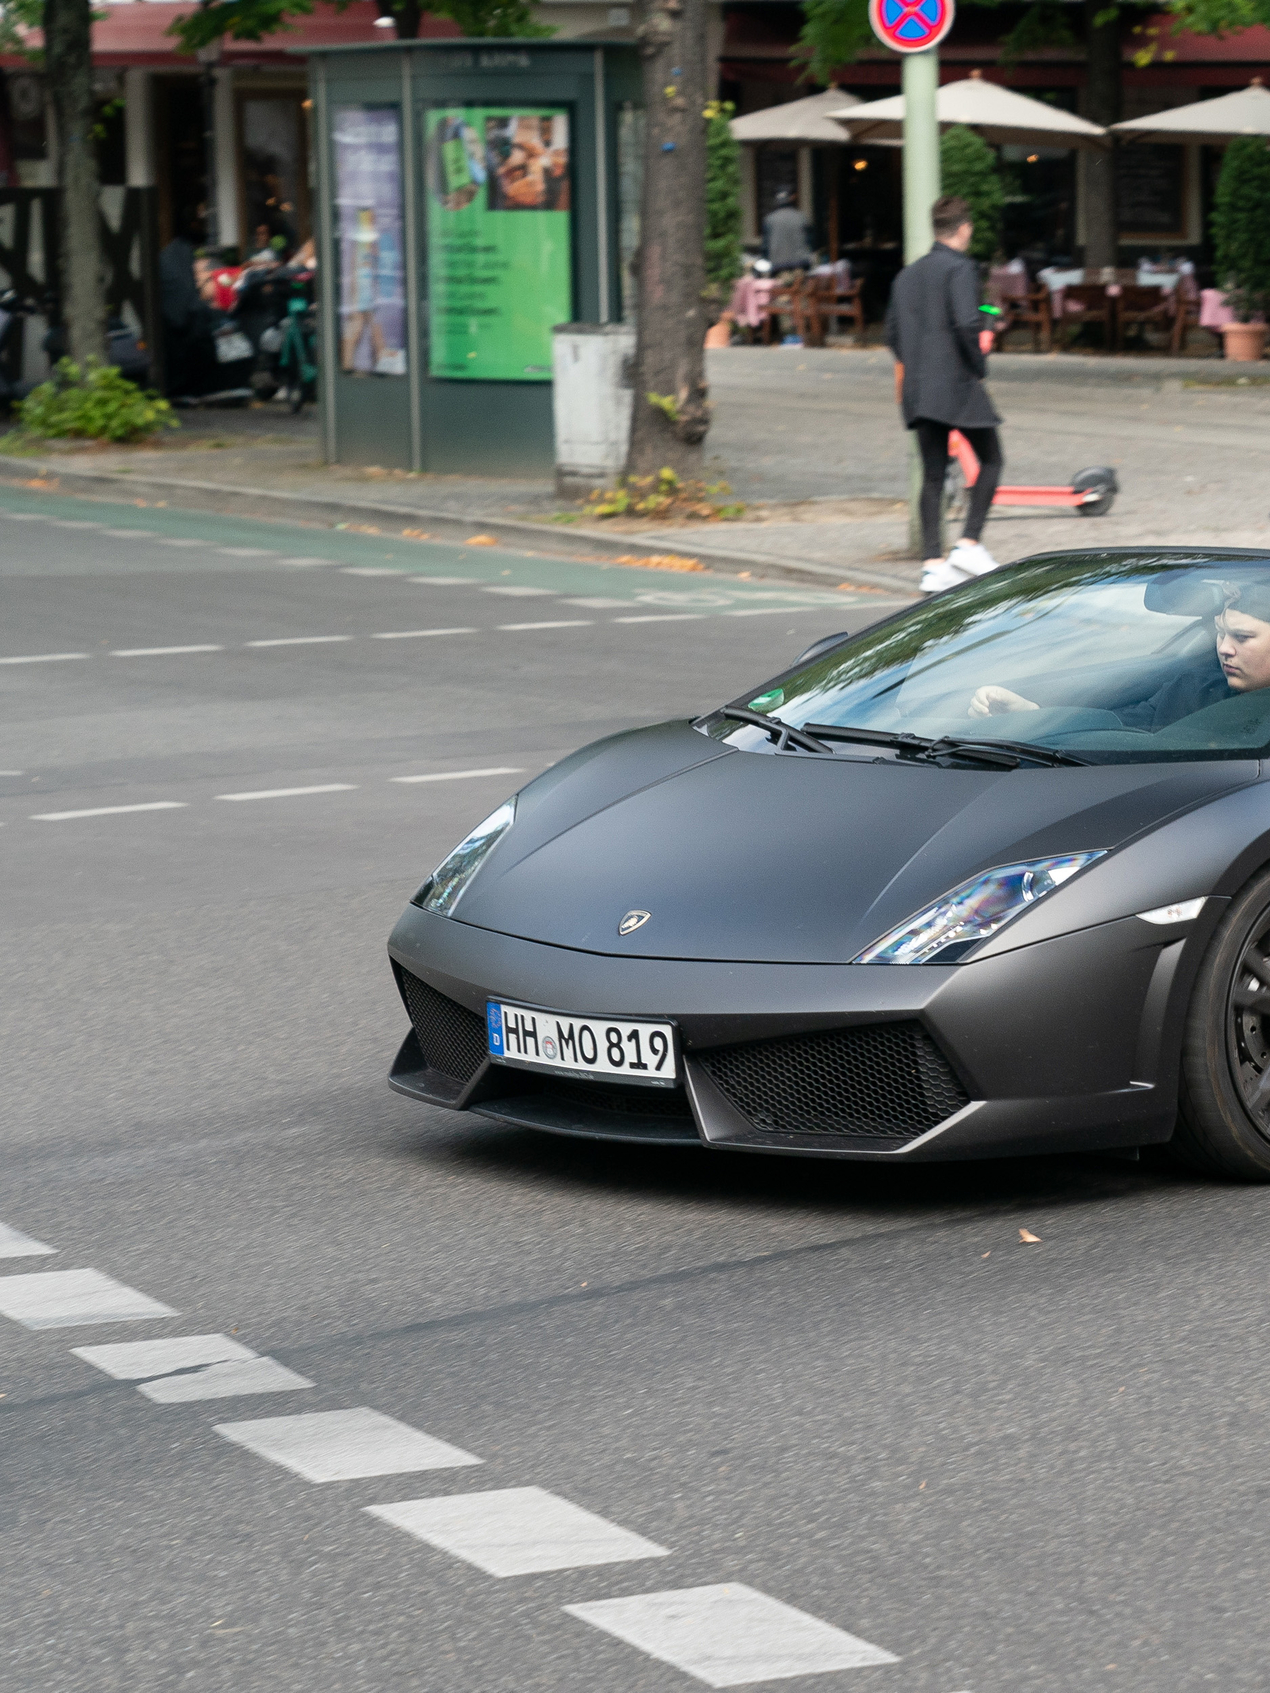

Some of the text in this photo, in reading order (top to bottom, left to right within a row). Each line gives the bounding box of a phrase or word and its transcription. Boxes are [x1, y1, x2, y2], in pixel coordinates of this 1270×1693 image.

[504, 1010, 669, 1072] HH MO 819
